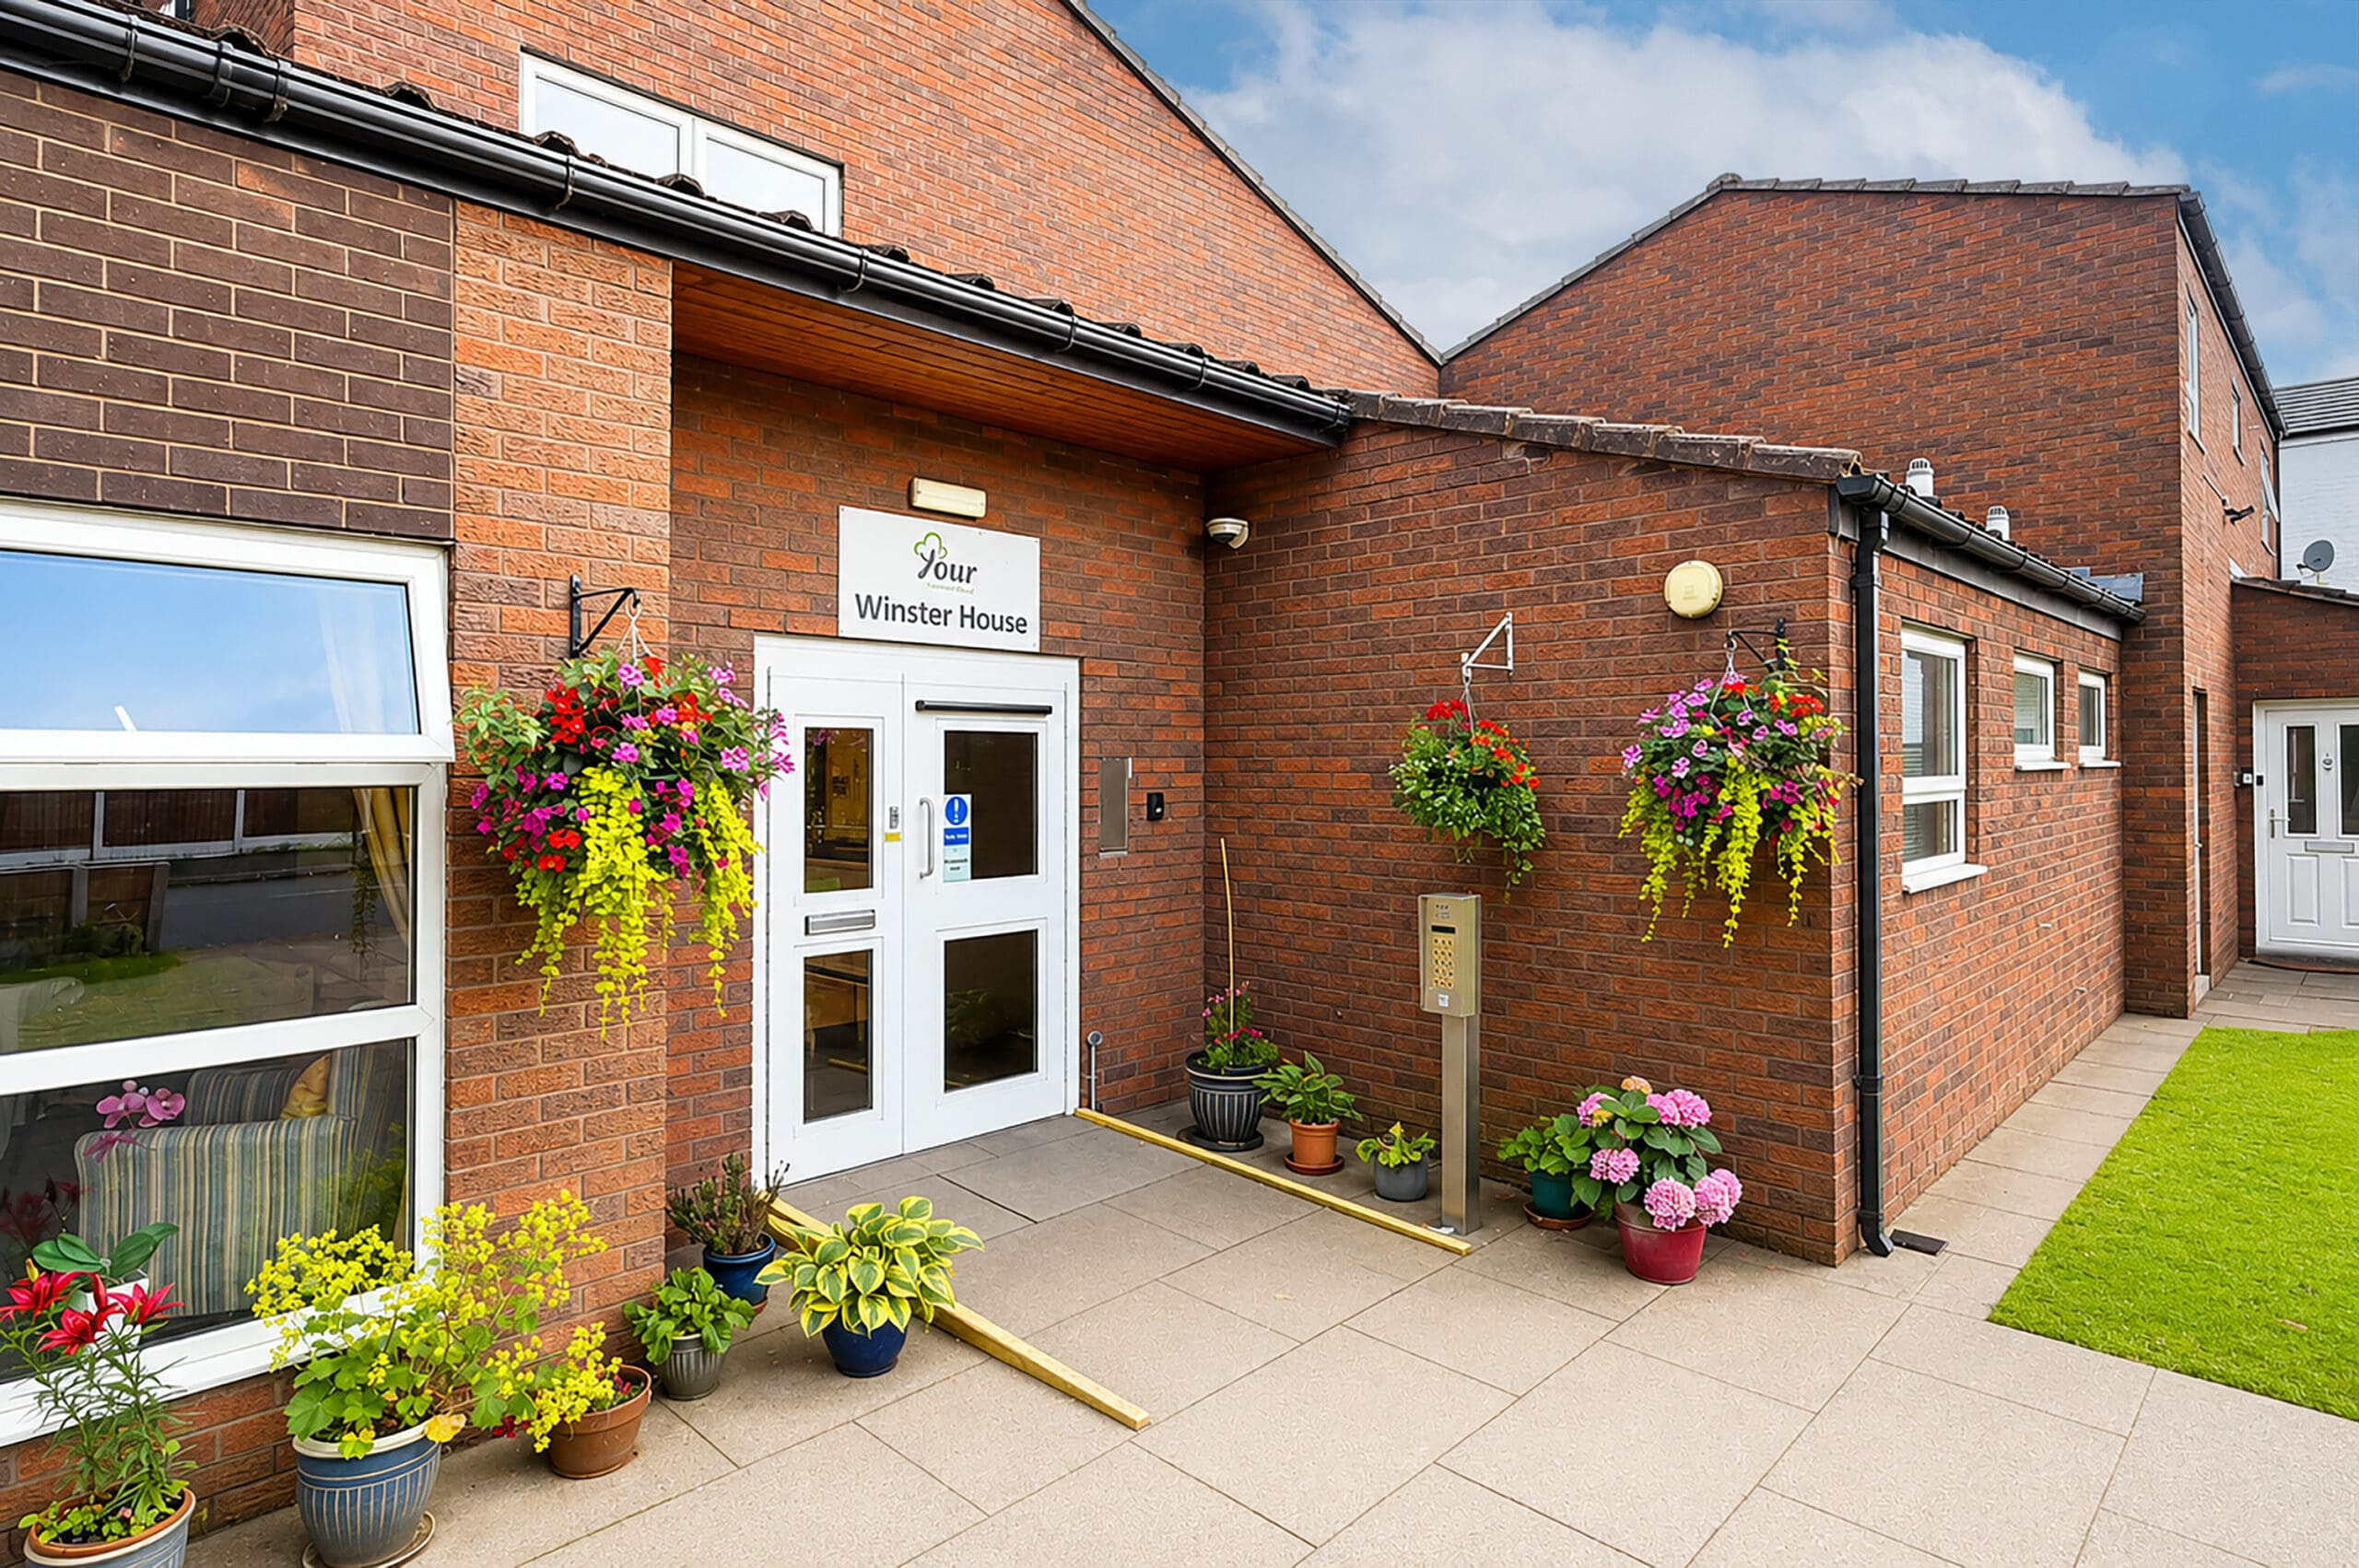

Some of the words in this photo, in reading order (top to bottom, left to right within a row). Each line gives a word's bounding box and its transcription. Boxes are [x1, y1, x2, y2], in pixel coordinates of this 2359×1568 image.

[917, 548, 978, 584] Your
[854, 592, 953, 627] Winster
[959, 604, 1027, 635] House
